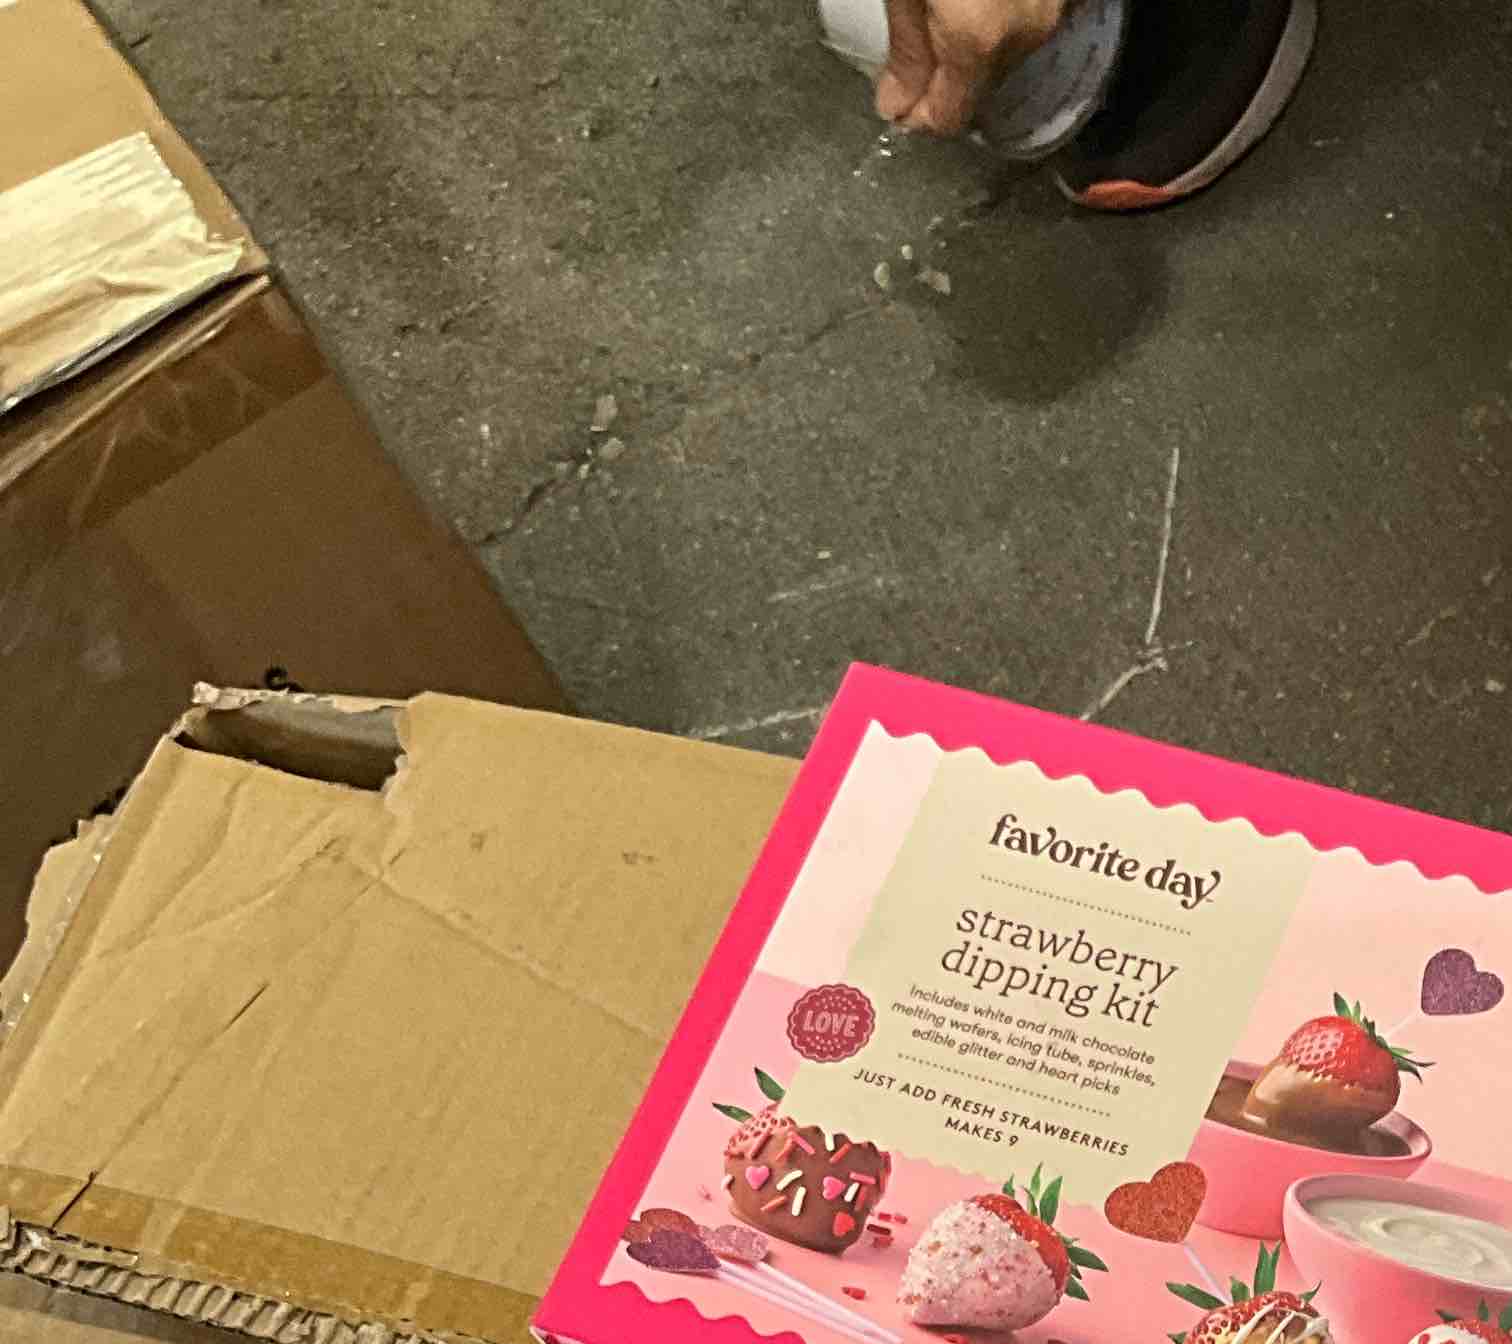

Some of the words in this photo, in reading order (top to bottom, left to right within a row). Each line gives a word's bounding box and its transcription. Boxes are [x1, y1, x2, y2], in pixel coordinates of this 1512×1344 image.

[988, 813, 1141, 882] favorite
[1144, 859, 1221, 909] day
[941, 940, 1097, 1017] dipping
[1101, 983, 1160, 1027] kit
[956, 904, 1178, 988] strawberry
[802, 1012, 858, 1039] LOVE
[891, 1001, 945, 1028] melting
[949, 1019, 1002, 1043] wafers,
[1007, 1034, 1042, 1057] icing
[1046, 1043, 1082, 1065] tube,
[1087, 1056, 1156, 1087] sprinkles,
[910, 984, 969, 1013] Includes
[974, 1005, 1013, 1026] white
[1016, 1017, 1046, 1035] and
[1049, 1025, 1079, 1043] milk
[1082, 1035, 1156, 1065] chocolate
[911, 1026, 956, 1050] edible
[958, 1039, 1003, 1063] glitter
[1006, 1053, 1037, 1072] and
[1039, 1062, 1078, 1083] heart
[1081, 1074, 1121, 1096] picks
[853, 1068, 898, 1090] JUST
[898, 1082, 937, 1102] ADD
[942, 1094, 996, 1119] FRESH
[999, 1110, 1129, 1157] STRAWBERRIES
[945, 1116, 1003, 1144] MAKES
[1008, 1135, 1019, 1148] 9
